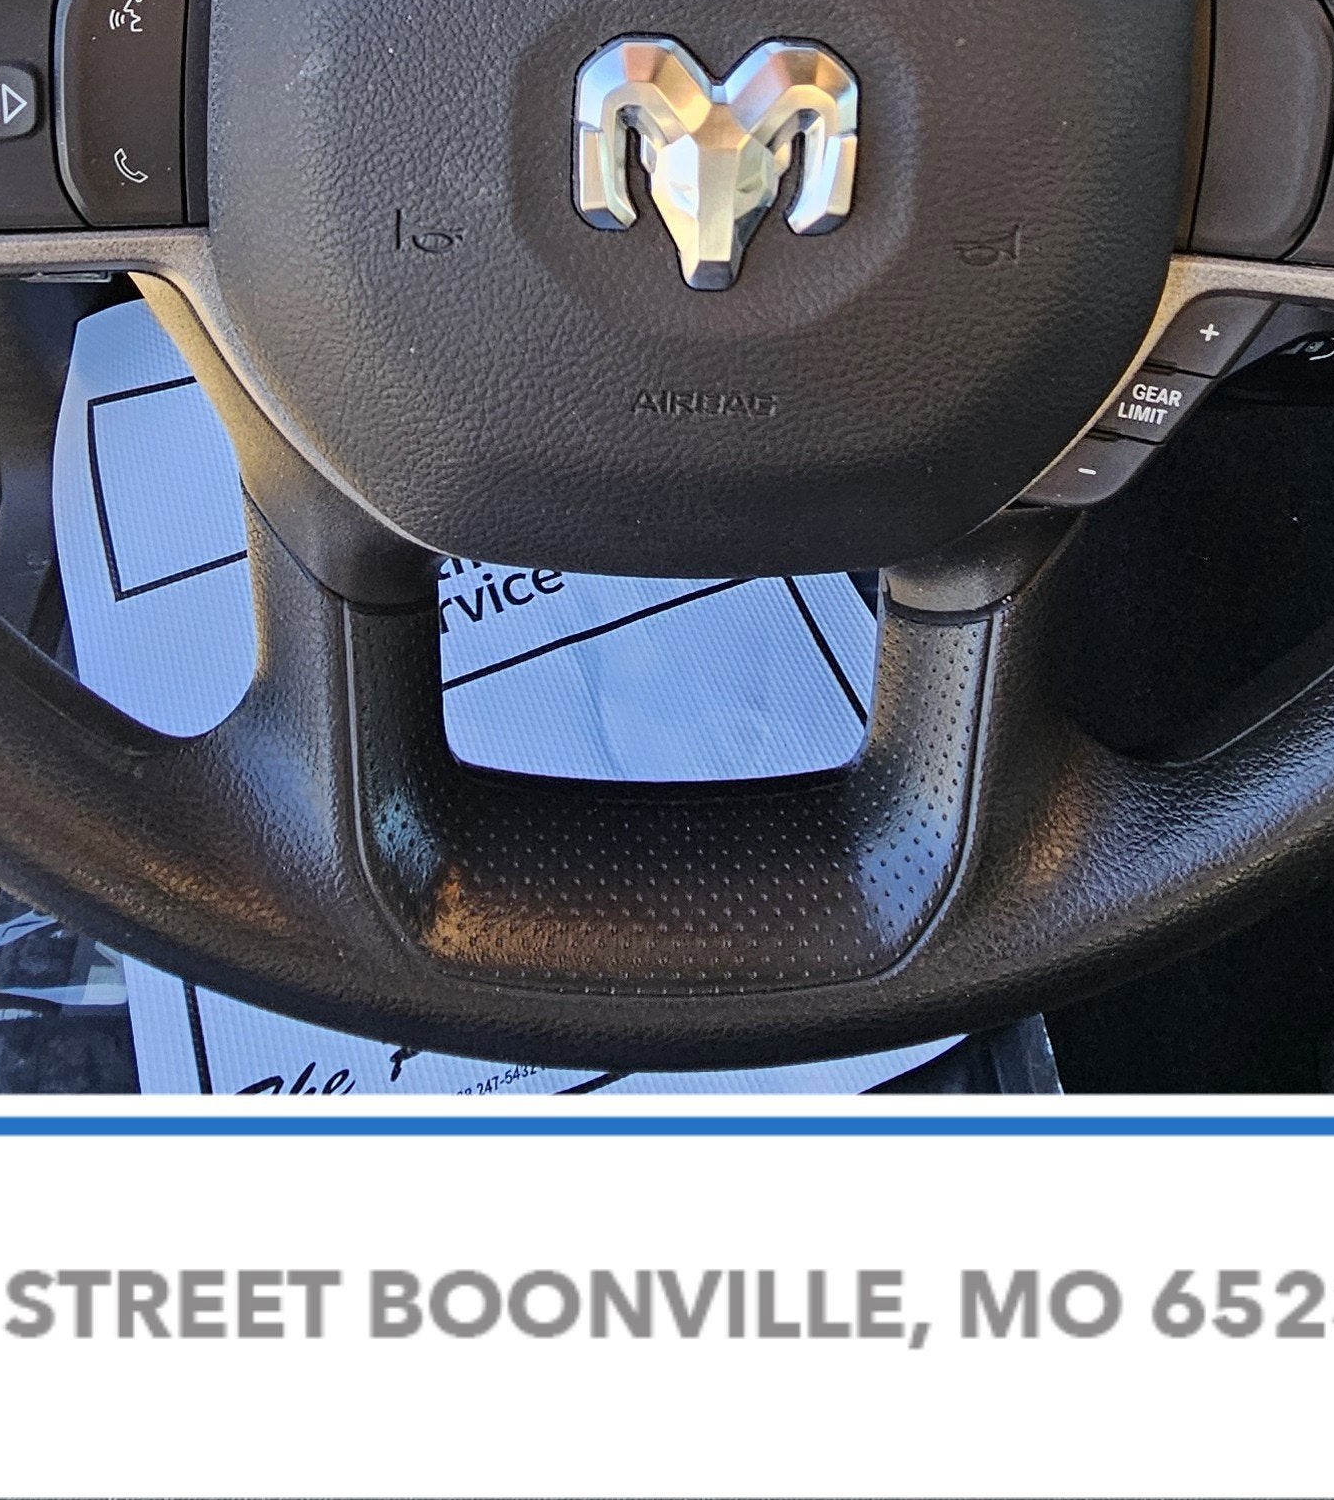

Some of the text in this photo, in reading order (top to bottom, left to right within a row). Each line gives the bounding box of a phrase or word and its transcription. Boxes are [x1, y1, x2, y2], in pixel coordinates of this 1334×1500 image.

[1132, 383, 1182, 408] GEAR
[1117, 402, 1168, 427] LIMIT
[440, 569, 565, 634] rvice
